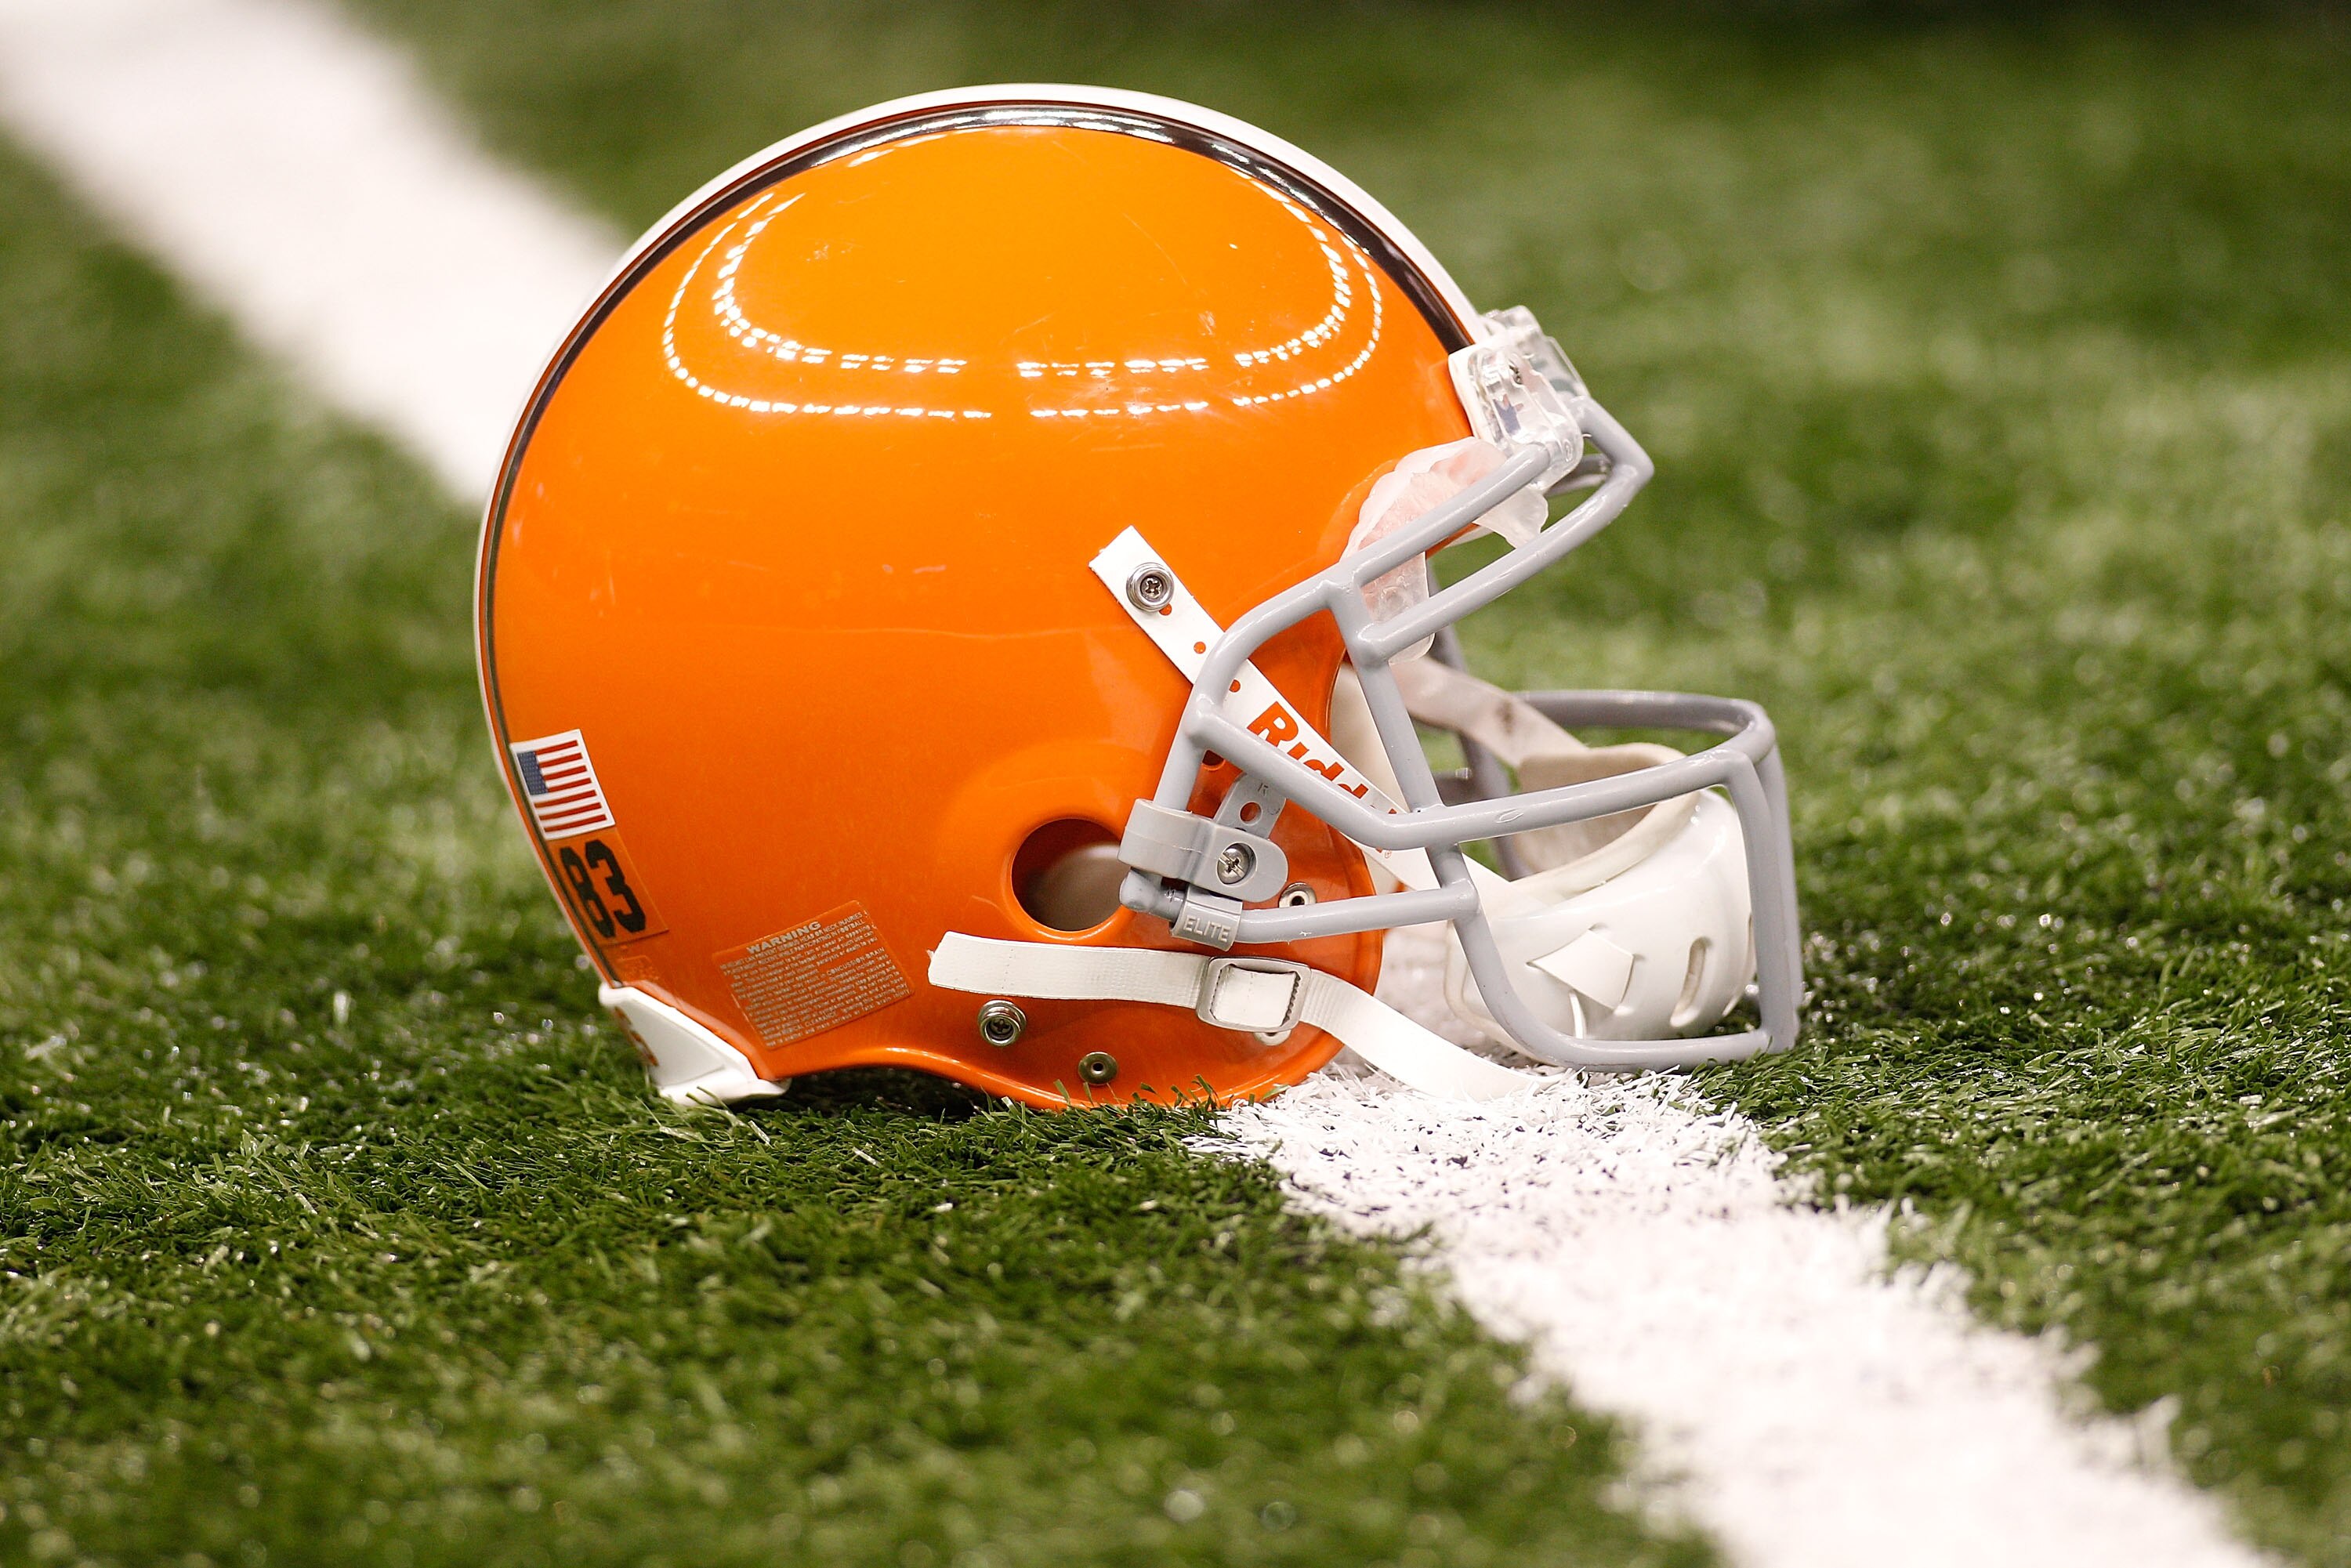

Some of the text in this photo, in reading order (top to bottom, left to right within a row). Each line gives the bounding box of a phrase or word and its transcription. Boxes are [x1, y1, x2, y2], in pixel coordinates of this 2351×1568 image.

[560, 839, 647, 939] 83
[746, 920, 821, 954] WARNING
[1183, 915, 1231, 943] ELITE
